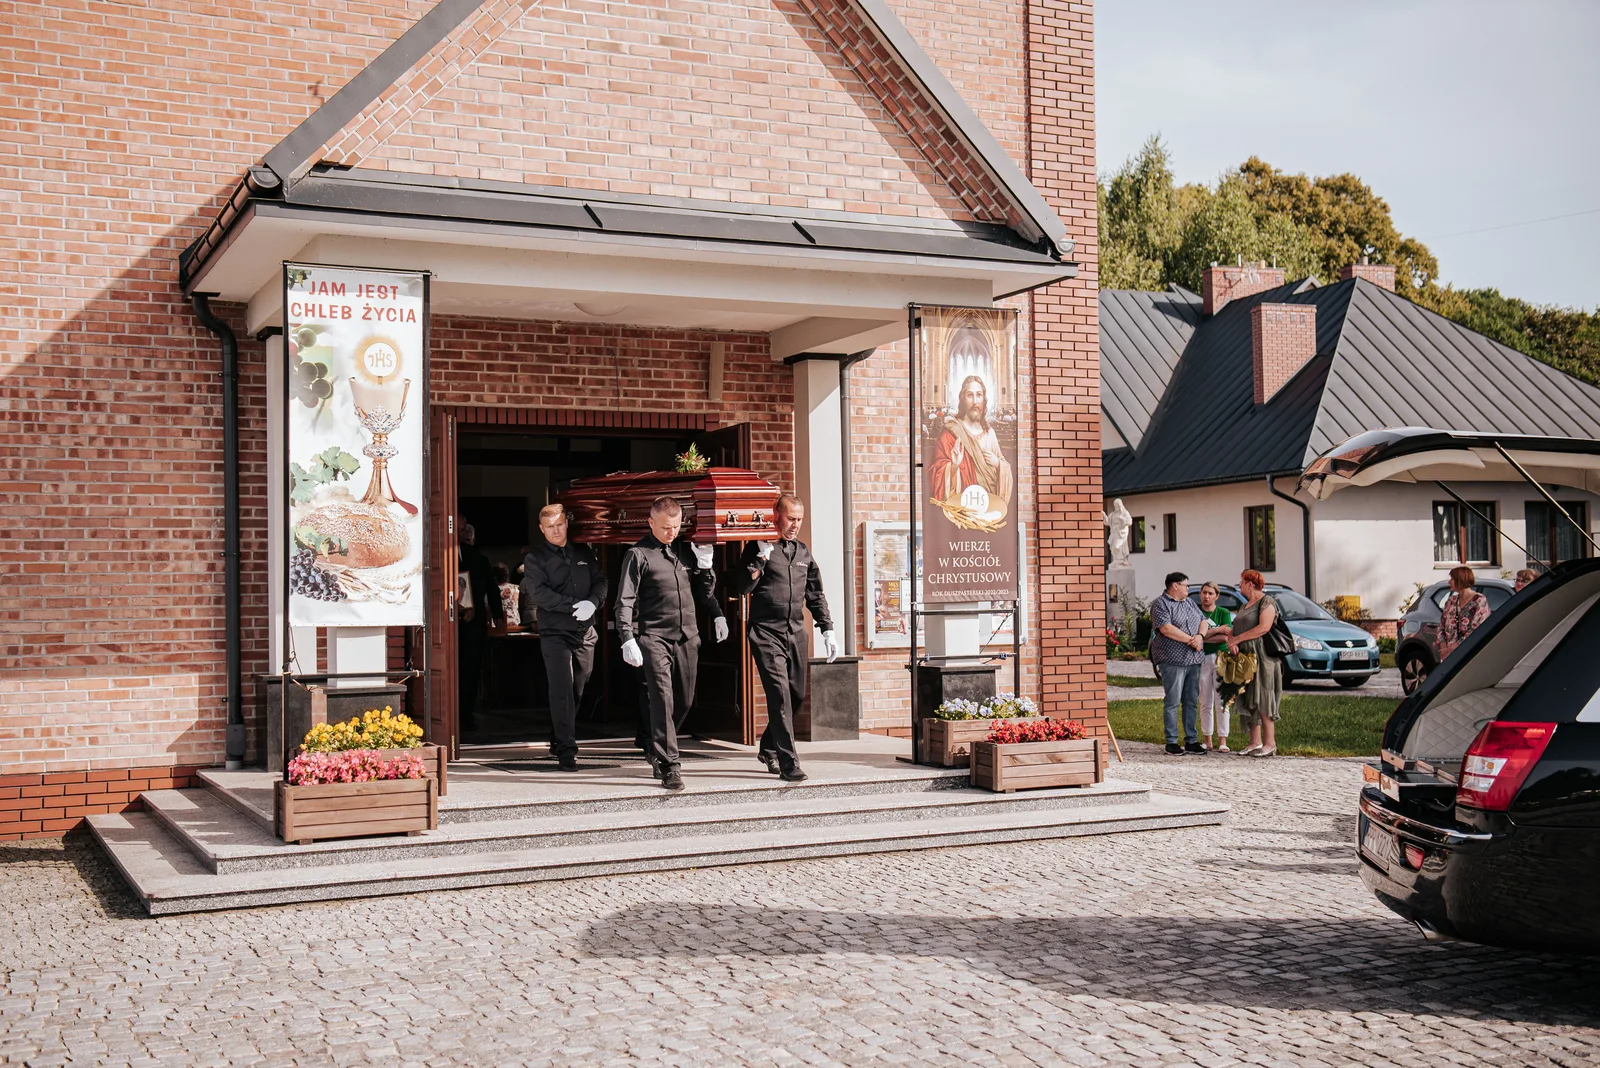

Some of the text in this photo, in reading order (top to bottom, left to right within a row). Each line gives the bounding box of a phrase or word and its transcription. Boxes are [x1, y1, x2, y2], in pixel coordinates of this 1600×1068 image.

[308, 281, 399, 300] JAM JEST
[290, 302, 417, 323] CHLEB ŻYCIA
[949, 540, 991, 554] WIERZĘ
[938, 555, 1002, 568] W KOŚCIÓŁ
[928, 571, 1012, 584] CHRYSTUSOWY
[944, 589, 984, 597] DUSZPASTERSKI
